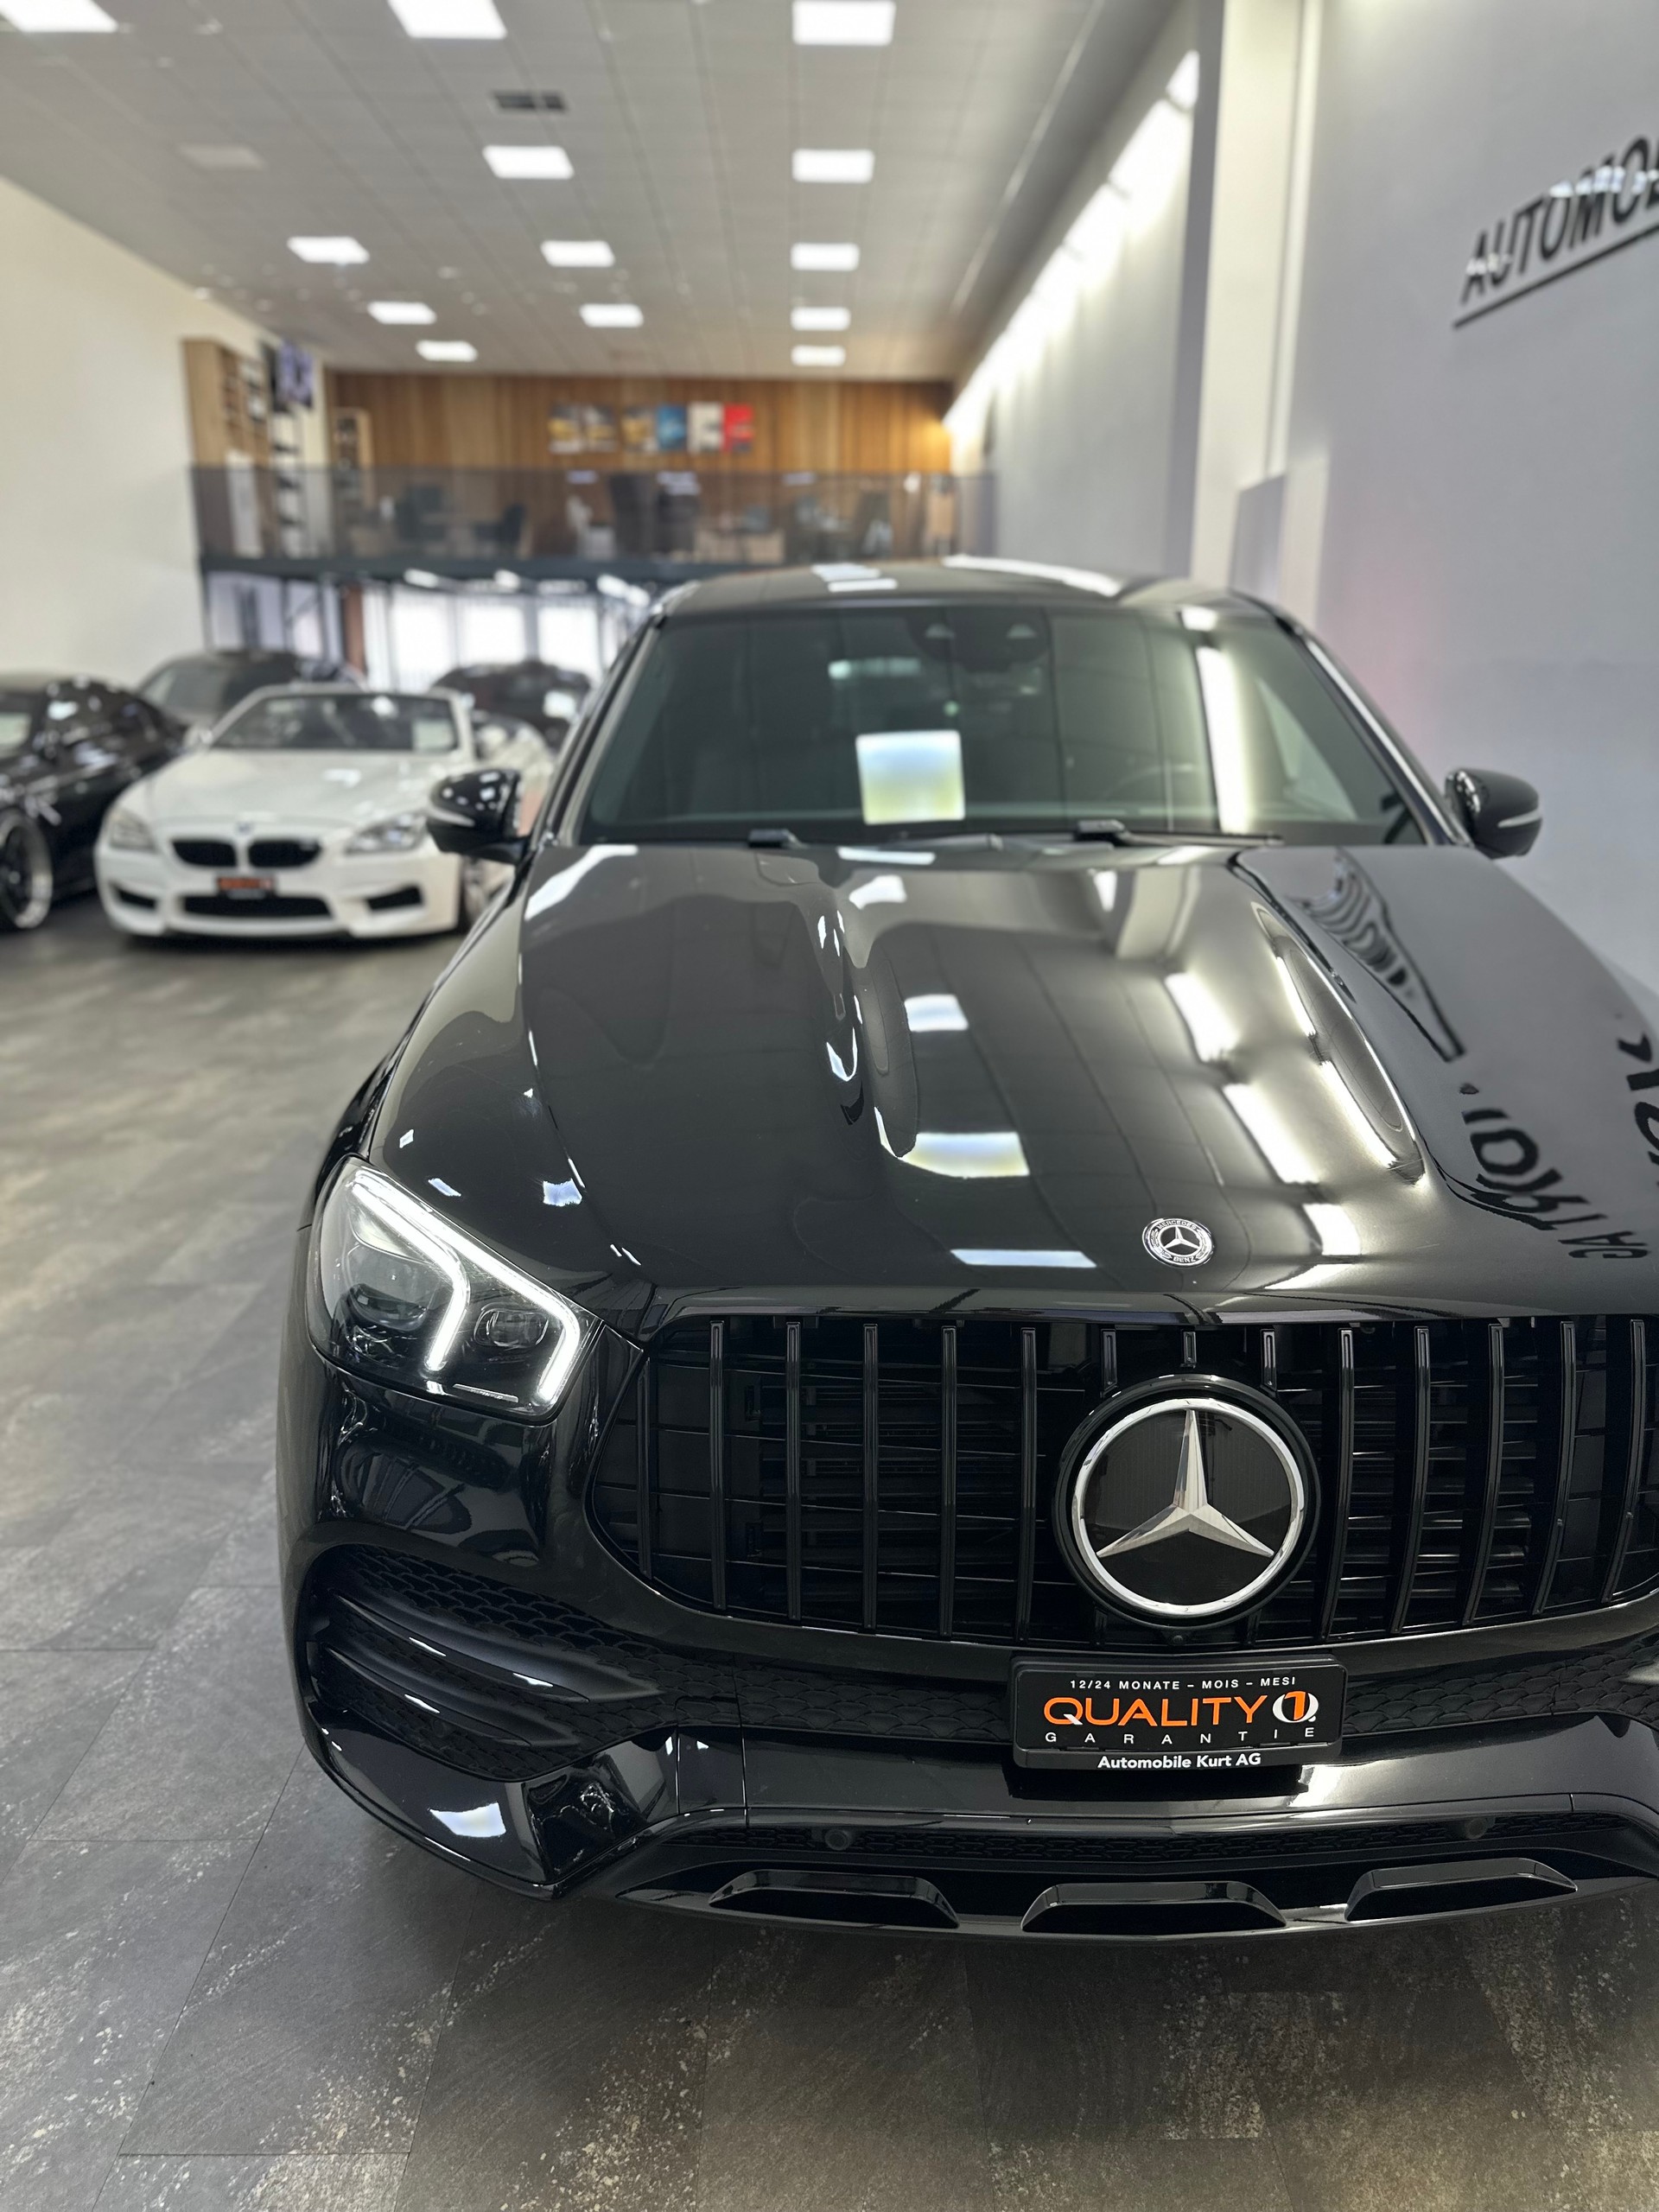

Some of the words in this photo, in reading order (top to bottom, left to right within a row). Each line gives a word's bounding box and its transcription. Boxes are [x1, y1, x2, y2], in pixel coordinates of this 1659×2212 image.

[1460, 134, 1659, 305] AUTOMO
[1157, 1220, 1197, 1230] MERCEDES
[1070, 1680, 1110, 1689] 12/24
[1119, 1681, 1180, 1690] MONATE
[1202, 1679, 1239, 1689] MOIS
[1261, 1676, 1295, 1687] MESI
[1044, 1694, 1268, 1726] QUALITY
[1097, 1755, 1192, 1769] Automobile
[1197, 1754, 1232, 1768] Kurt
[1236, 1752, 1262, 1766] AG
